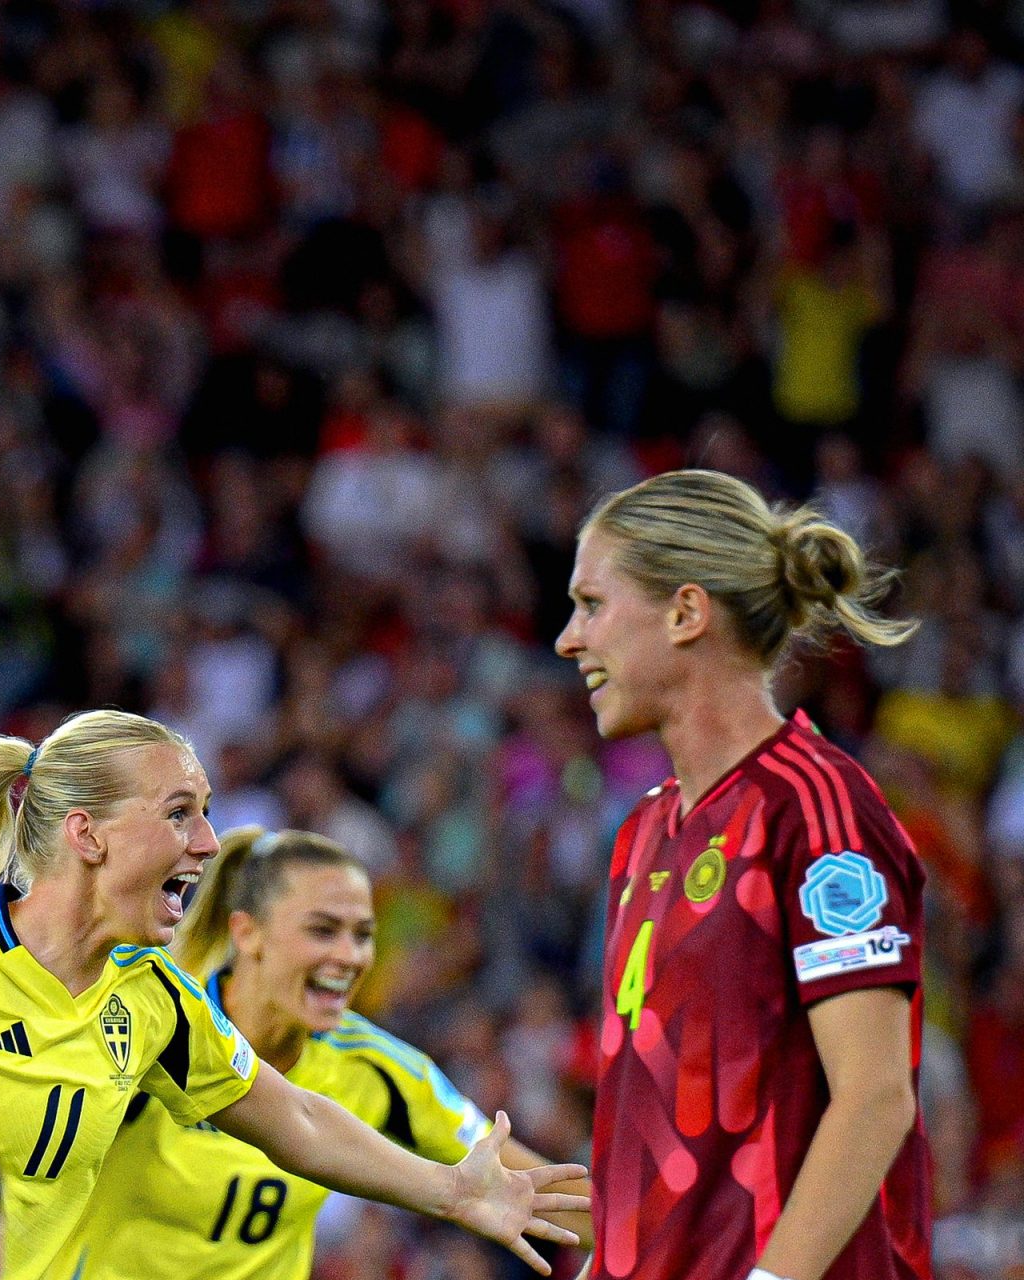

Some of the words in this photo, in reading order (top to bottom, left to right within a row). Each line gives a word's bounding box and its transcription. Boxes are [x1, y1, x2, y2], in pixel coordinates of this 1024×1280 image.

[616, 920, 654, 1030] 4
[23, 1084, 85, 1180] 11
[211, 1175, 287, 1244] 18
